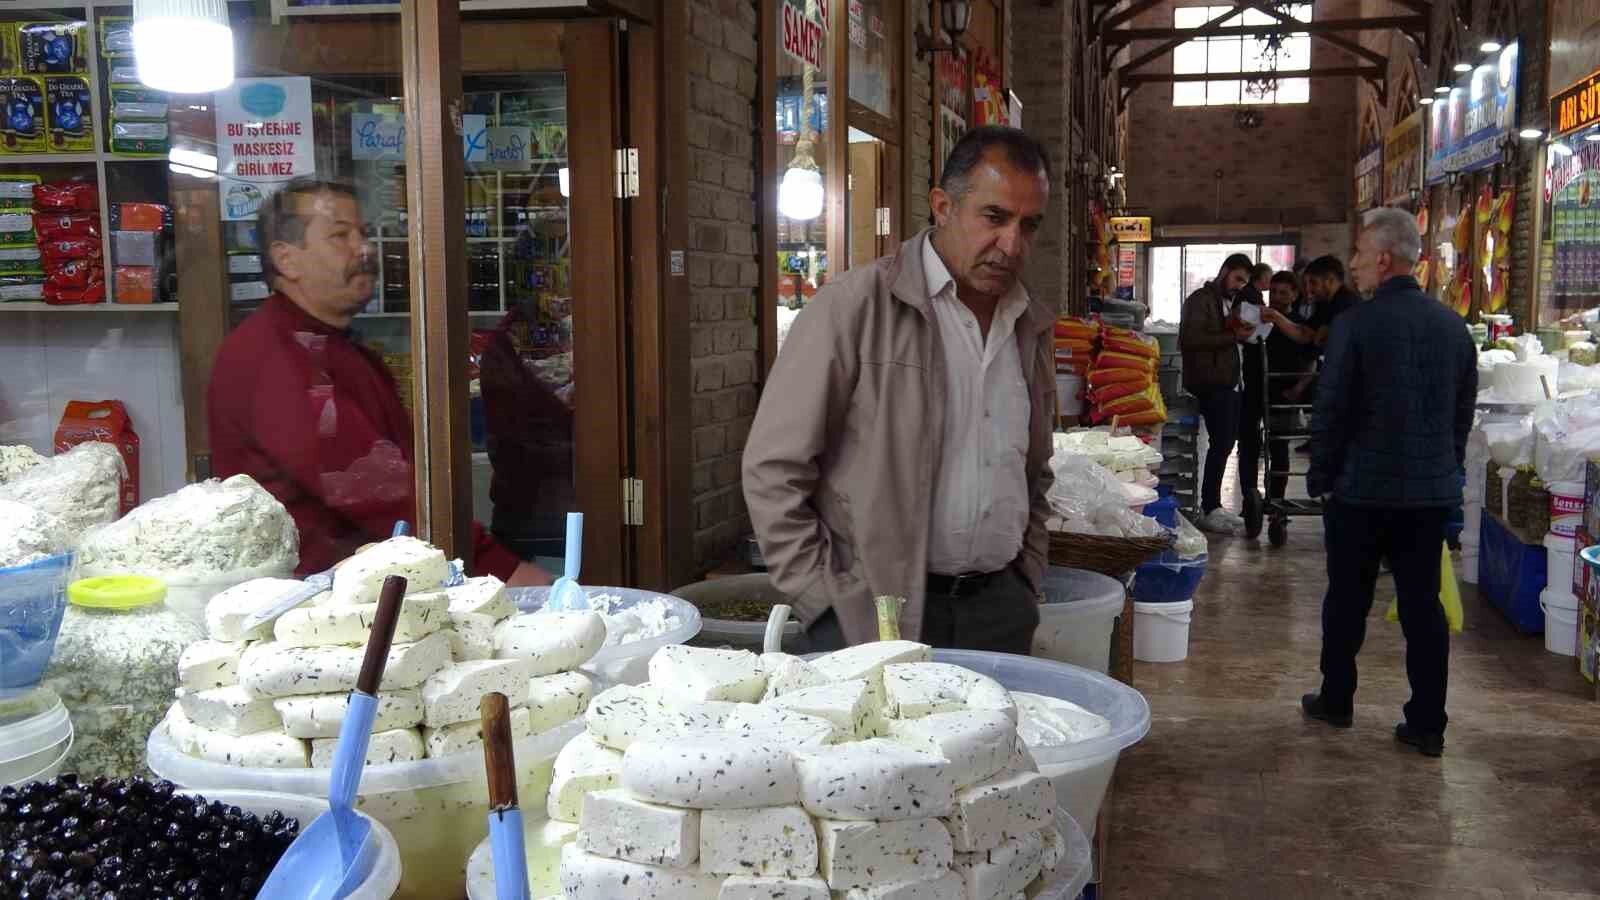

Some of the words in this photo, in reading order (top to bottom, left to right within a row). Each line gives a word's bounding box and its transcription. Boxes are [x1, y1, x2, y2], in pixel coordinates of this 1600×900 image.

[784, 4, 822, 69] SAMET
[1560, 95, 1577, 131] ARI
[227, 123, 242, 136] BU
[247, 120, 301, 138] İŞYERİNE
[233, 140, 294, 156] MASKESİZ
[236, 160, 293, 176] GİRİLMEZ
